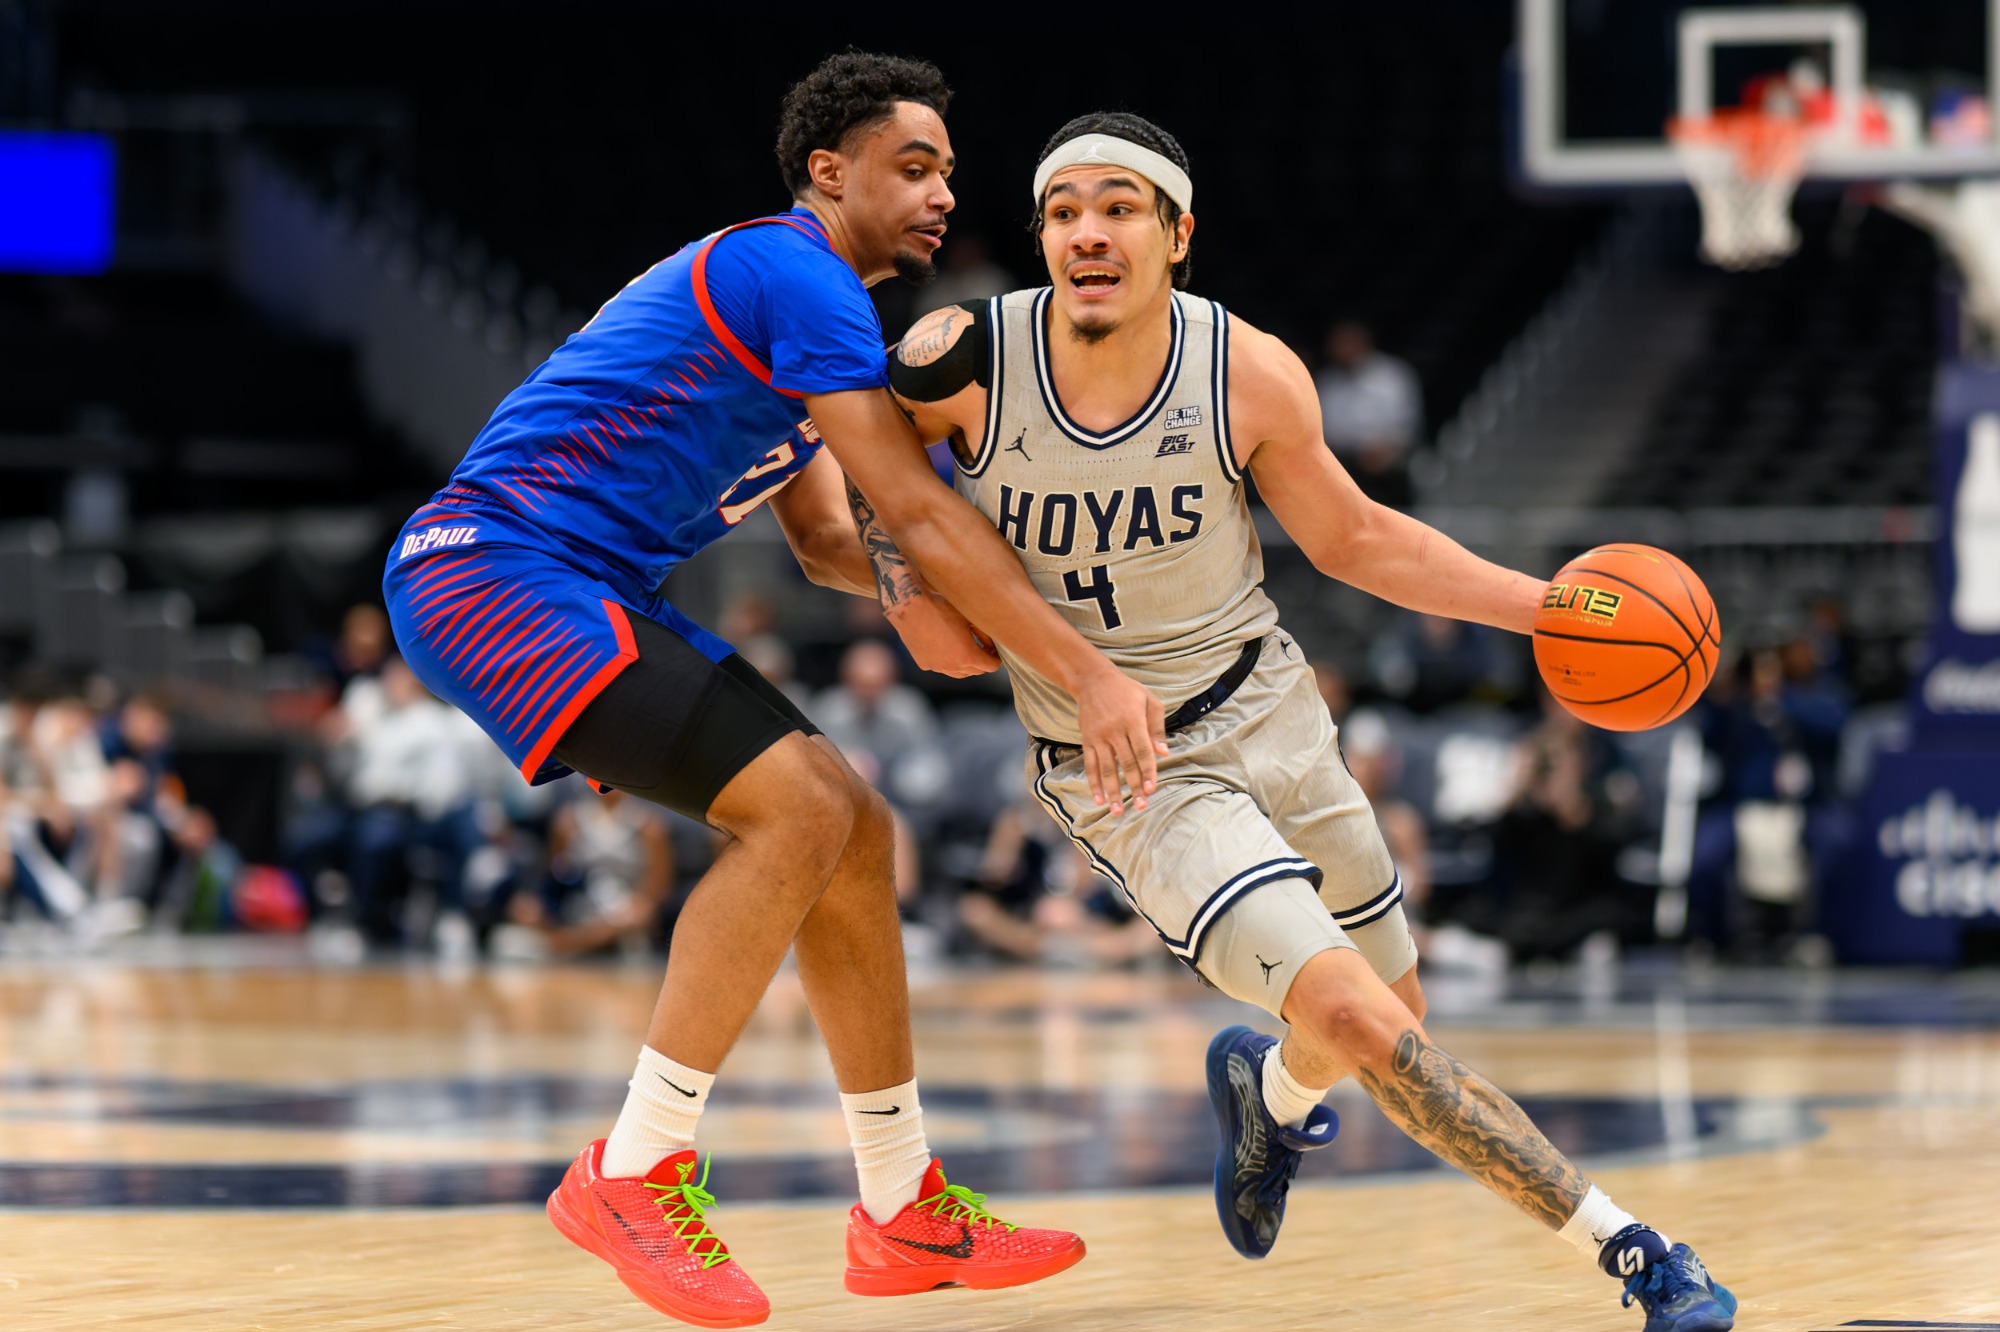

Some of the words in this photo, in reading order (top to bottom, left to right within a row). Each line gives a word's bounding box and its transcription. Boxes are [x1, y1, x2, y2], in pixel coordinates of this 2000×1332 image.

[1167, 409, 1180, 420] BE
[1181, 406, 1199, 418] THE
[1164, 415, 1202, 430] CHANGE
[1161, 434, 1189, 445] BIG
[1157, 442, 1196, 454] EAST
[998, 483, 1203, 558] HOYAS
[1060, 563, 1123, 632] 4
